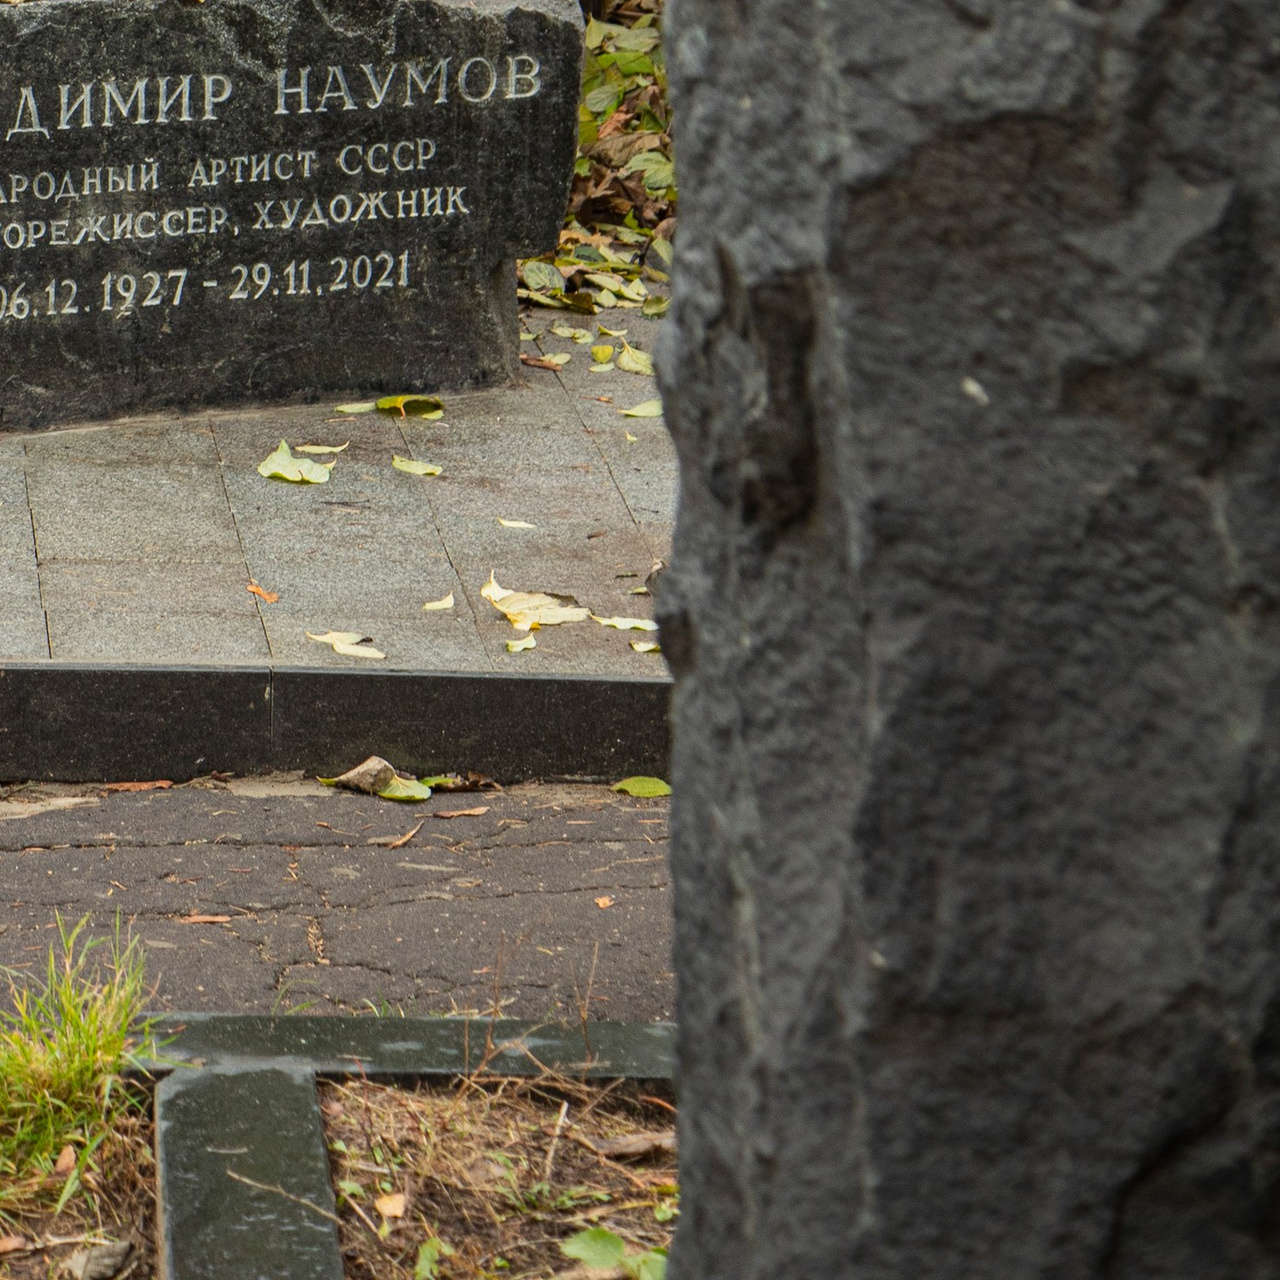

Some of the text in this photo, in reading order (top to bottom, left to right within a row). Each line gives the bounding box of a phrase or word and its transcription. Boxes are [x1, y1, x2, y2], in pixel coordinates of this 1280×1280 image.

[273, 55, 542, 116] НАУМОВ
[187, 149, 317, 188] АРТИСТ
[338, 138, 437, 176] СССР
[252, 185, 471, 230] ХУДОЖНИК
